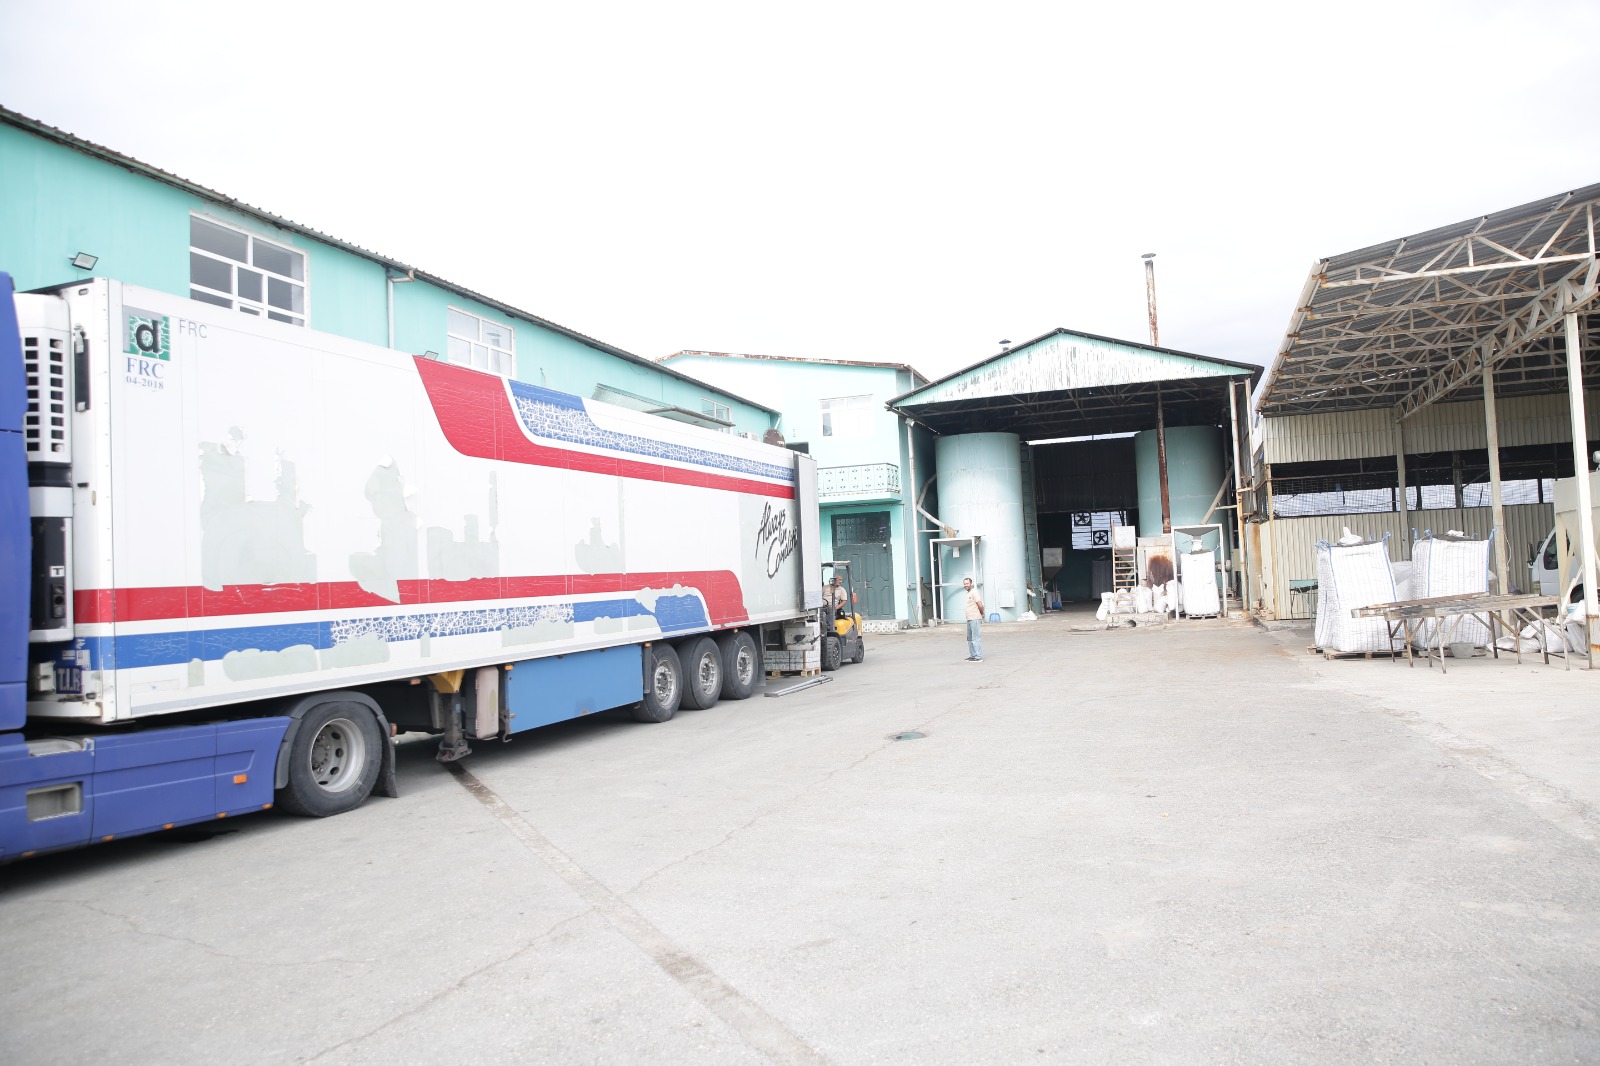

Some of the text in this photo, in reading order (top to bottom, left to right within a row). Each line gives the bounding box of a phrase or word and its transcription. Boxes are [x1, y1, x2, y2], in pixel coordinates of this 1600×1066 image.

[179, 318, 208, 339] FRC
[126, 356, 165, 379] FRC
[126, 375, 165, 389] 04-2018
